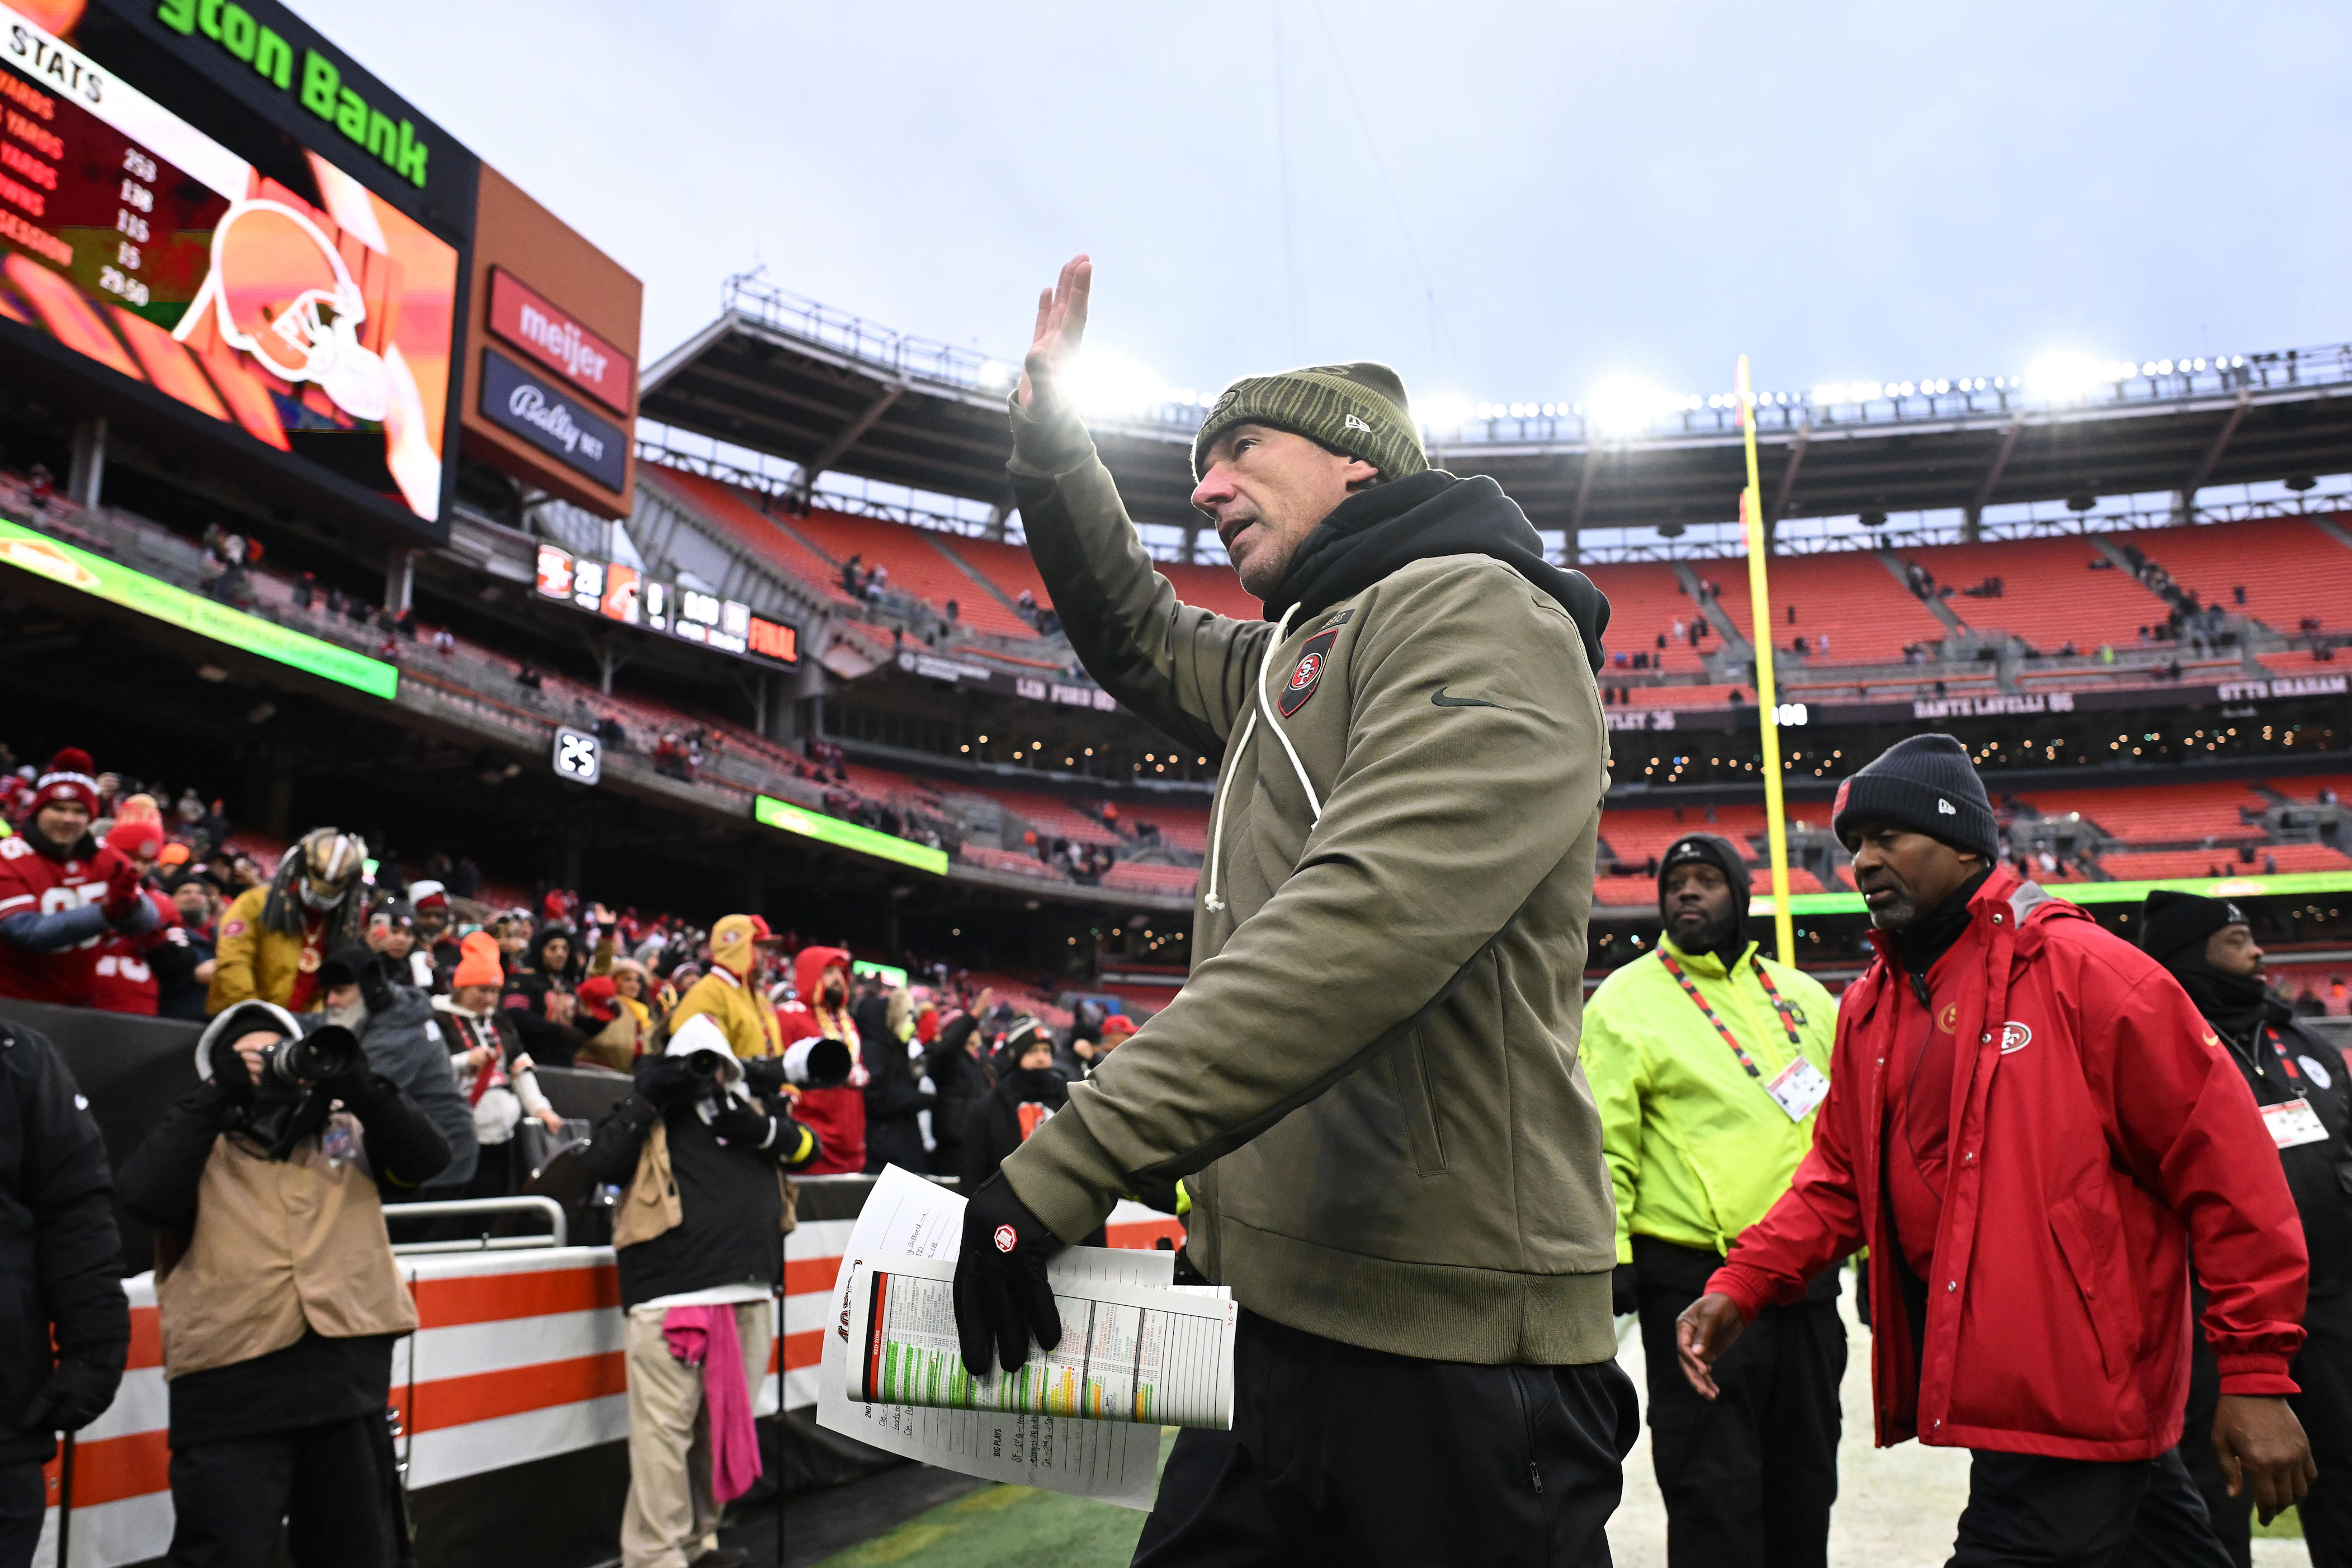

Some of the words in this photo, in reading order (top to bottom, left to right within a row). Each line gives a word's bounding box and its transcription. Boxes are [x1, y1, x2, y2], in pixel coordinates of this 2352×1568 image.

[10, 24, 103, 103] STATS
[300, 47, 428, 188] Bank
[521, 304, 608, 383] meijer
[509, 385, 580, 454] Bally
[749, 617, 797, 662] FINAL
[1297, 658, 1315, 686] SF
[1914, 699, 1973, 719] DANTE
[1974, 694, 2045, 715] LAVELLI
[560, 734, 595, 777] 25
[908, 1224, 921, 1246] Gifford
